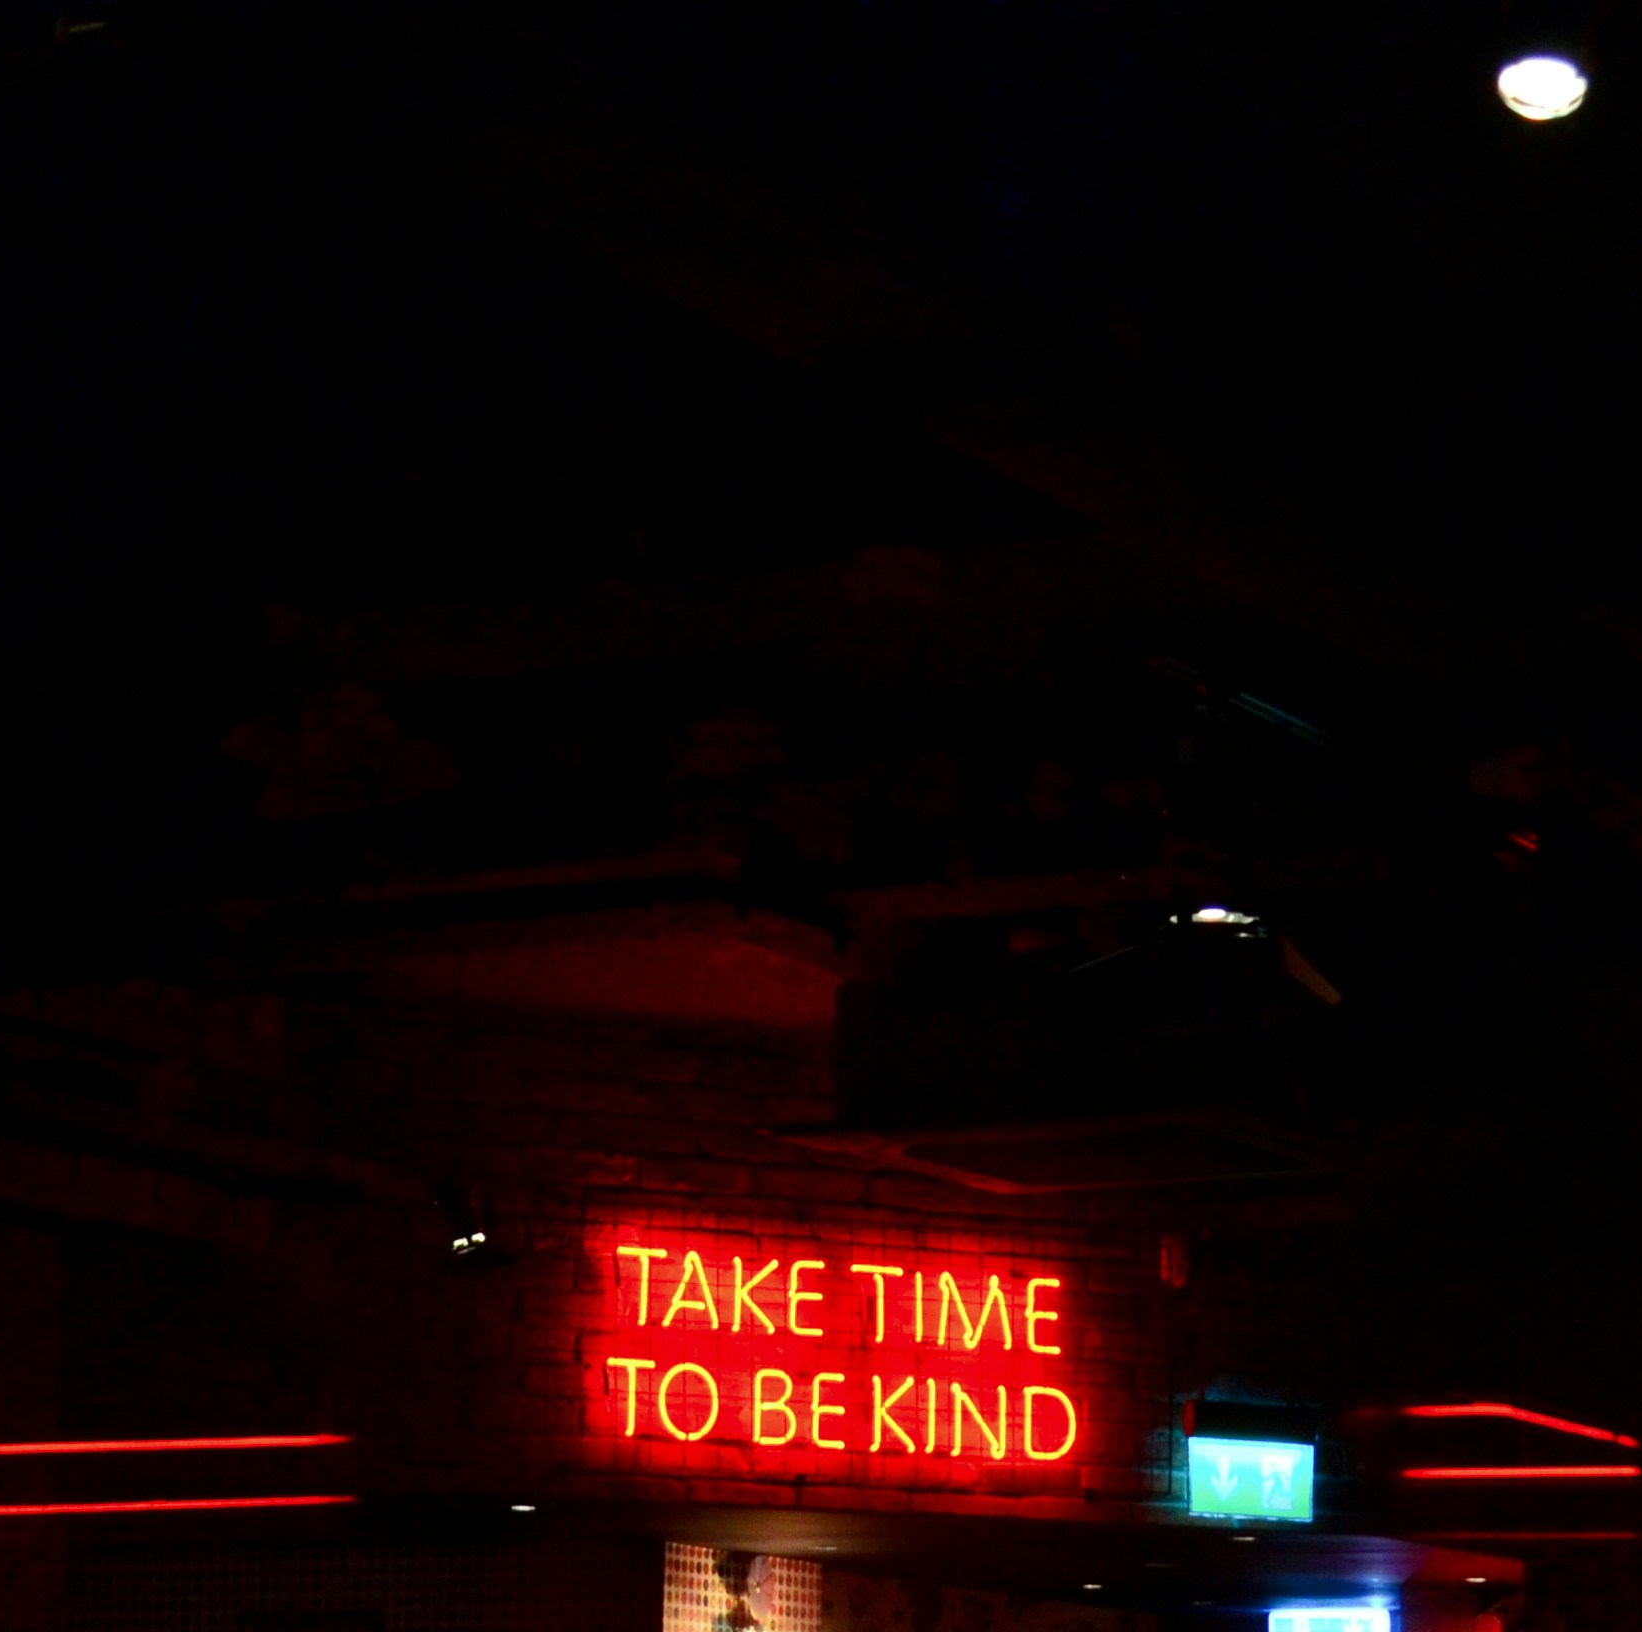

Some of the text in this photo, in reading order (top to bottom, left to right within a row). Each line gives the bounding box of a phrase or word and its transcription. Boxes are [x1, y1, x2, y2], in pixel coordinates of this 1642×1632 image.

[616, 1246, 1061, 1355] TAKE TIME
[606, 1357, 1077, 1461] TO BE KIND
